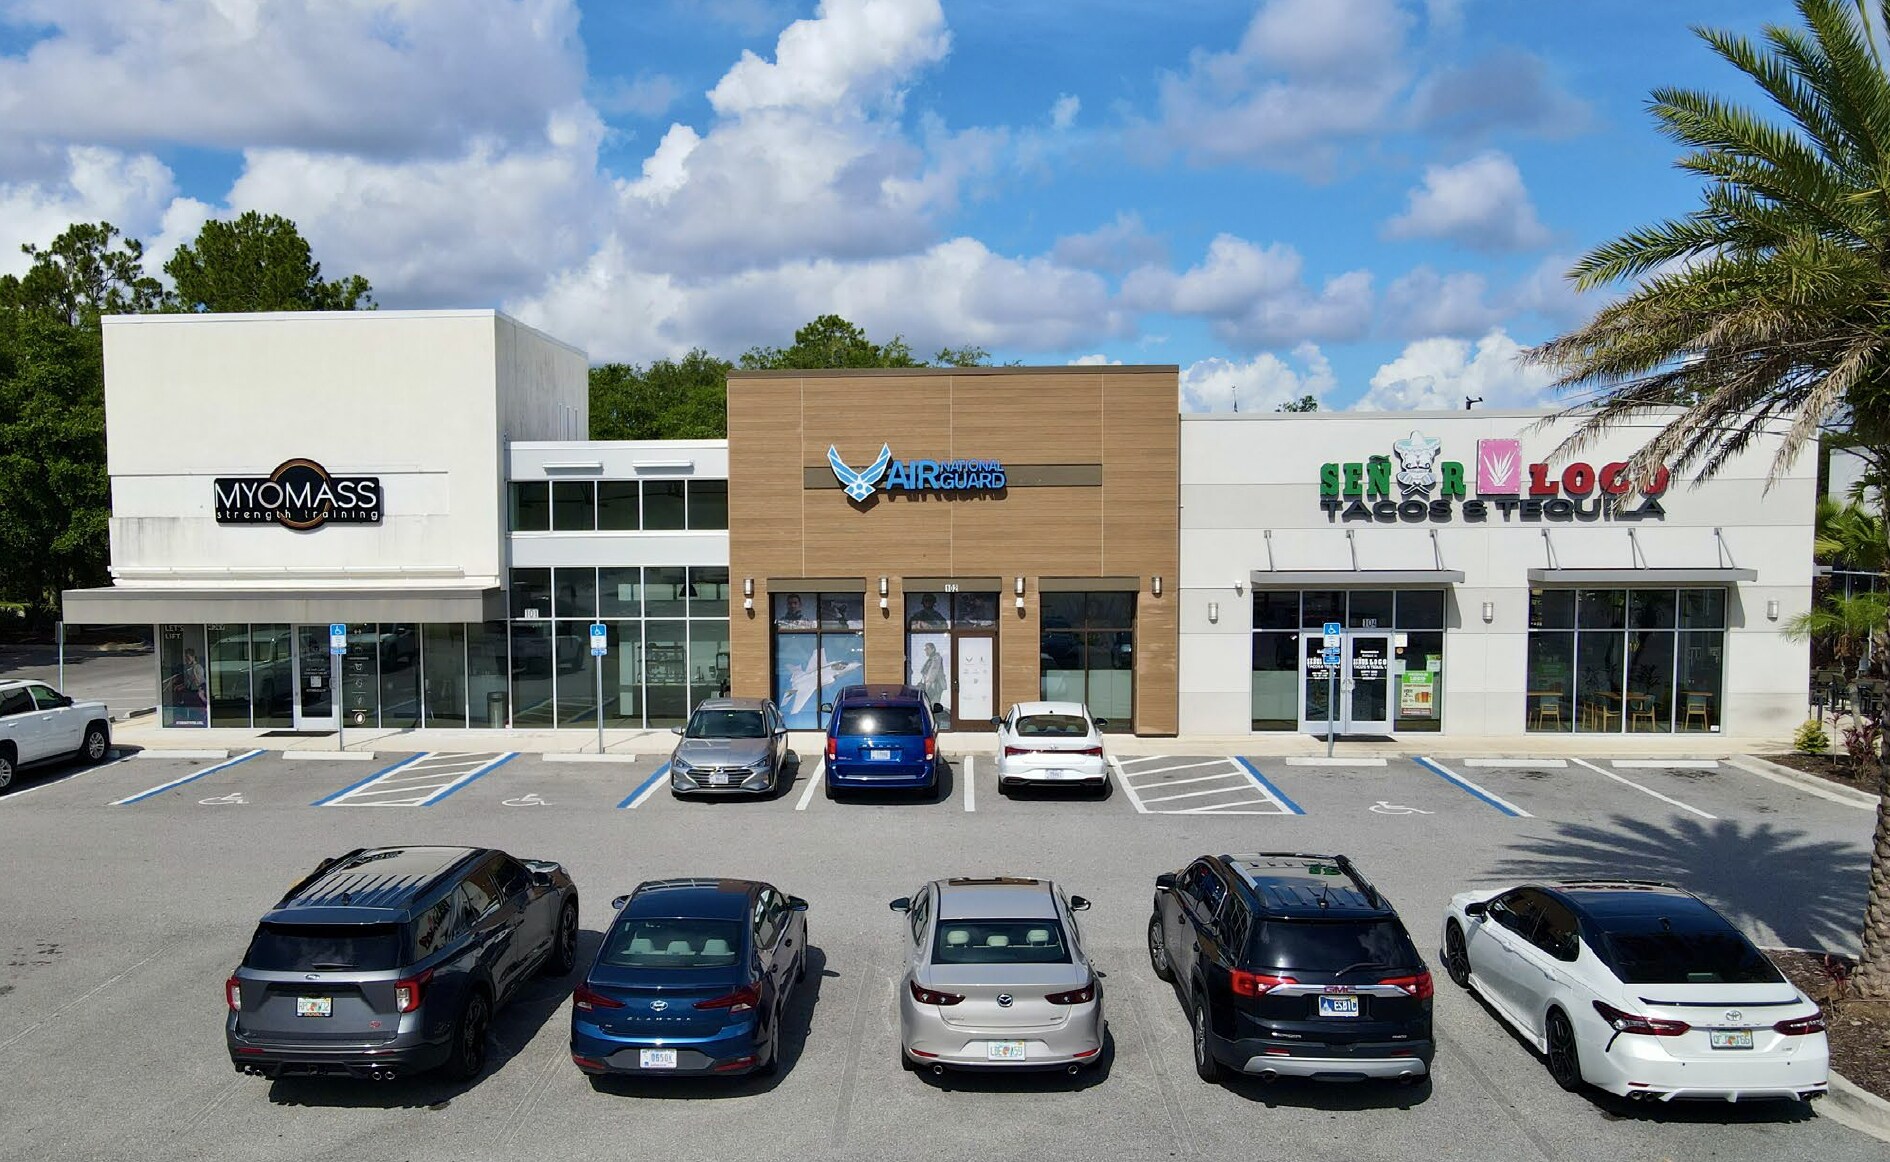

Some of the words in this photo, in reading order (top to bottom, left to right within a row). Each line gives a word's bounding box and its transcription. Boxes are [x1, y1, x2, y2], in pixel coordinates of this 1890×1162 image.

[886, 460, 941, 490] AIR
[940, 460, 1005, 472] NATIONAL
[940, 473, 1006, 489] GUARD
[1529, 462, 1670, 494] LOCO
[215, 481, 377, 508] MYOMASS
[216, 509, 292, 520] strength
[305, 510, 379, 520] training
[1320, 500, 1452, 519] TACOS
[1462, 500, 1487, 519] &
[1495, 499, 1666, 519] TEQUILA
